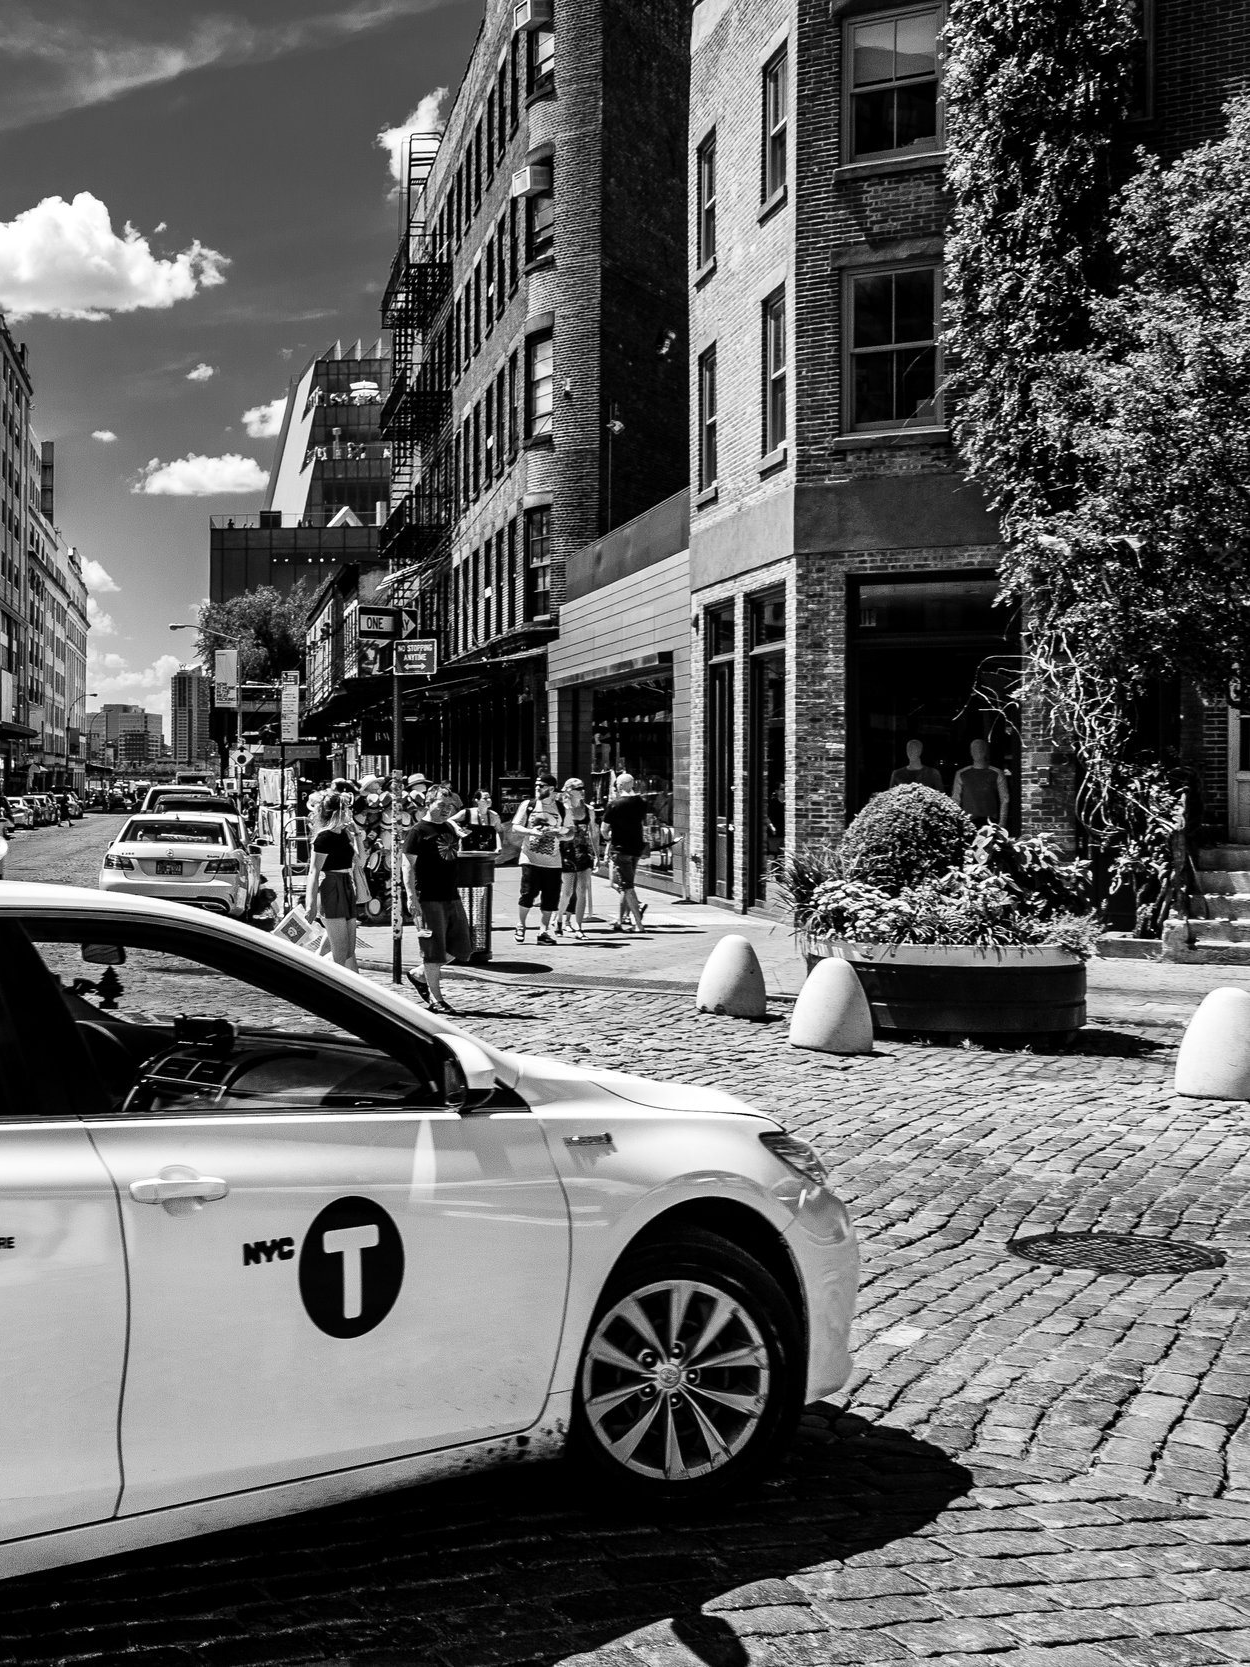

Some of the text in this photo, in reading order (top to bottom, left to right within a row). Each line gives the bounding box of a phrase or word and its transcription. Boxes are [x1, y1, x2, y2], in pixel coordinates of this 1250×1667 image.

[366, 616, 384, 630] ONE
[407, 644, 433, 652] STOPPING
[403, 653, 428, 661] ANYTIME
[242, 1223, 380, 1319] NYC T
